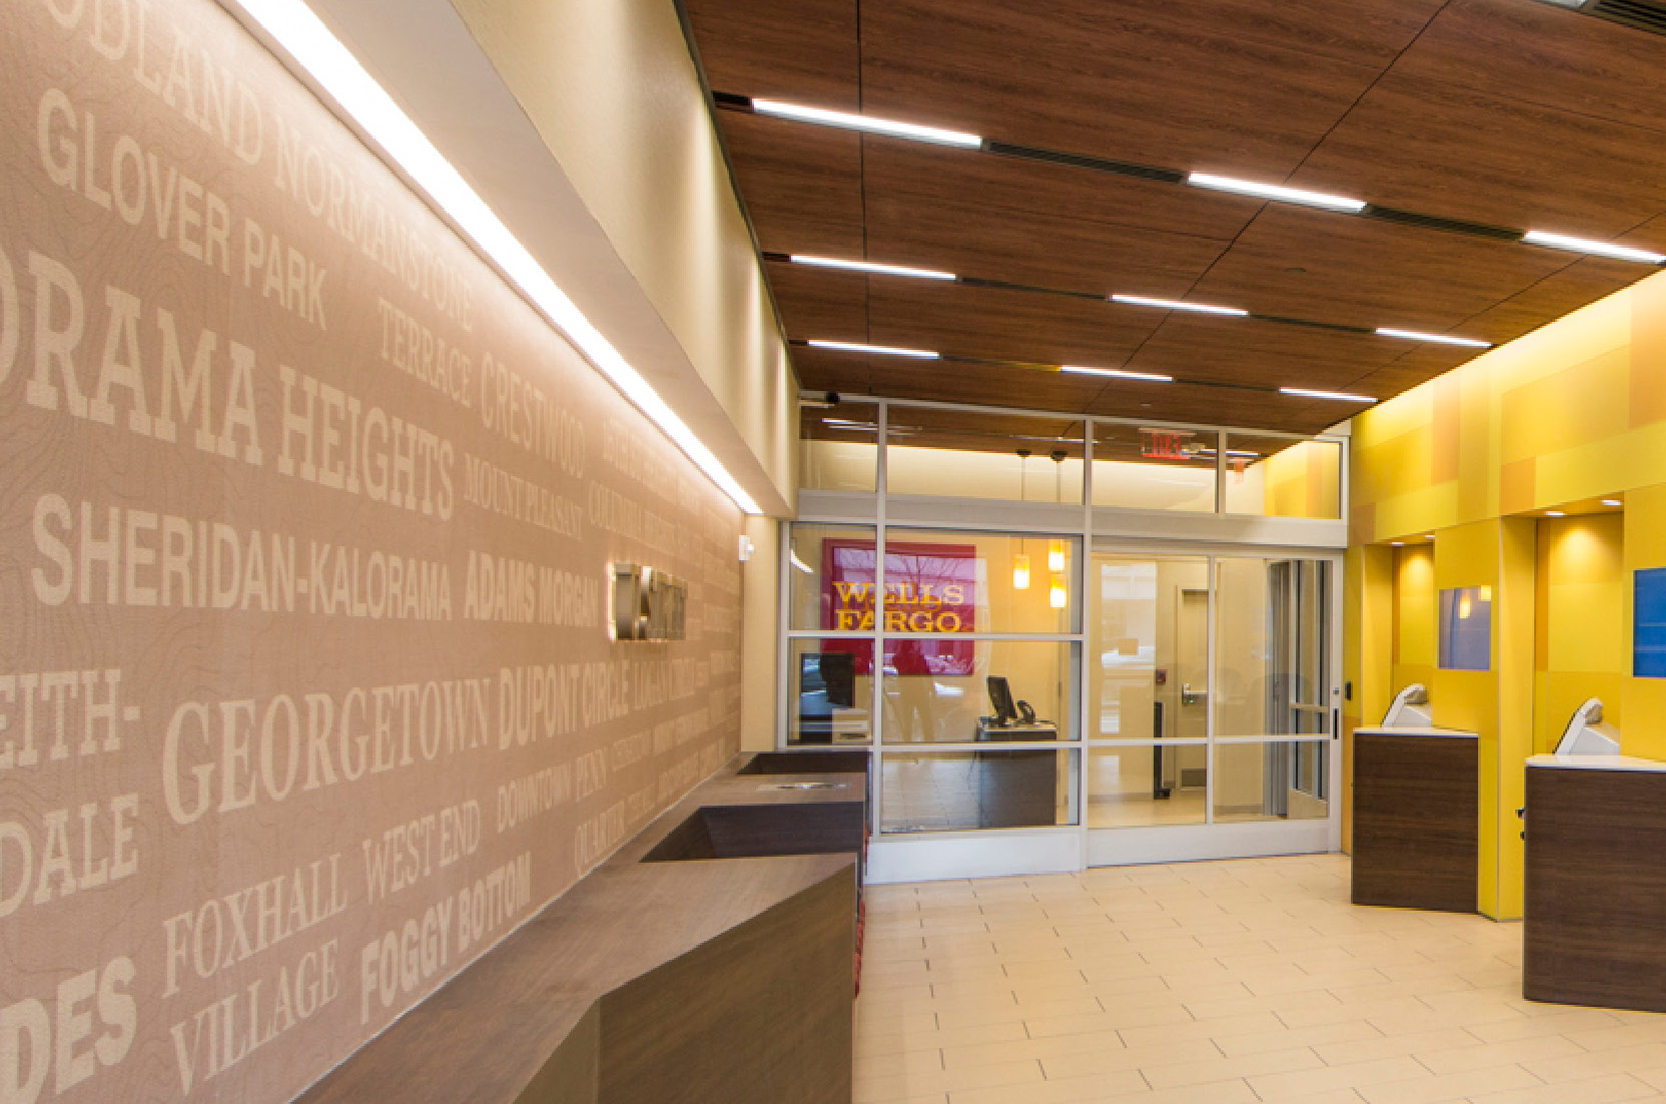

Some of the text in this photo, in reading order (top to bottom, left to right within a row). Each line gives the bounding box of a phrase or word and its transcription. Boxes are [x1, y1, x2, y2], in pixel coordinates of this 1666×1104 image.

[47, 0, 263, 166] DLAND
[37, 88, 327, 331] GLOVER PARK
[0, 246, 263, 466] RAMA
[278, 364, 455, 521] HEIGHTS
[377, 297, 472, 409] TERRACE
[480, 351, 586, 479] CRESTWOOD
[30, 493, 452, 621] SHERIDAN-KALORAMA
[464, 550, 535, 623] ADAMS
[539, 565, 598, 627] MORGAN
[832, 580, 964, 606] WELLS
[836, 608, 962, 633] FARGO
[163, 678, 491, 825] GEORGETOWN
[500, 664, 580, 750] DUPONT
[0, 793, 138, 917] DALE
[362, 800, 481, 904] WEST END
[163, 853, 348, 999] FOXHALL
[361, 852, 532, 1025] FOGGY BOTTOM
[170, 939, 340, 1095] VILLAGE
